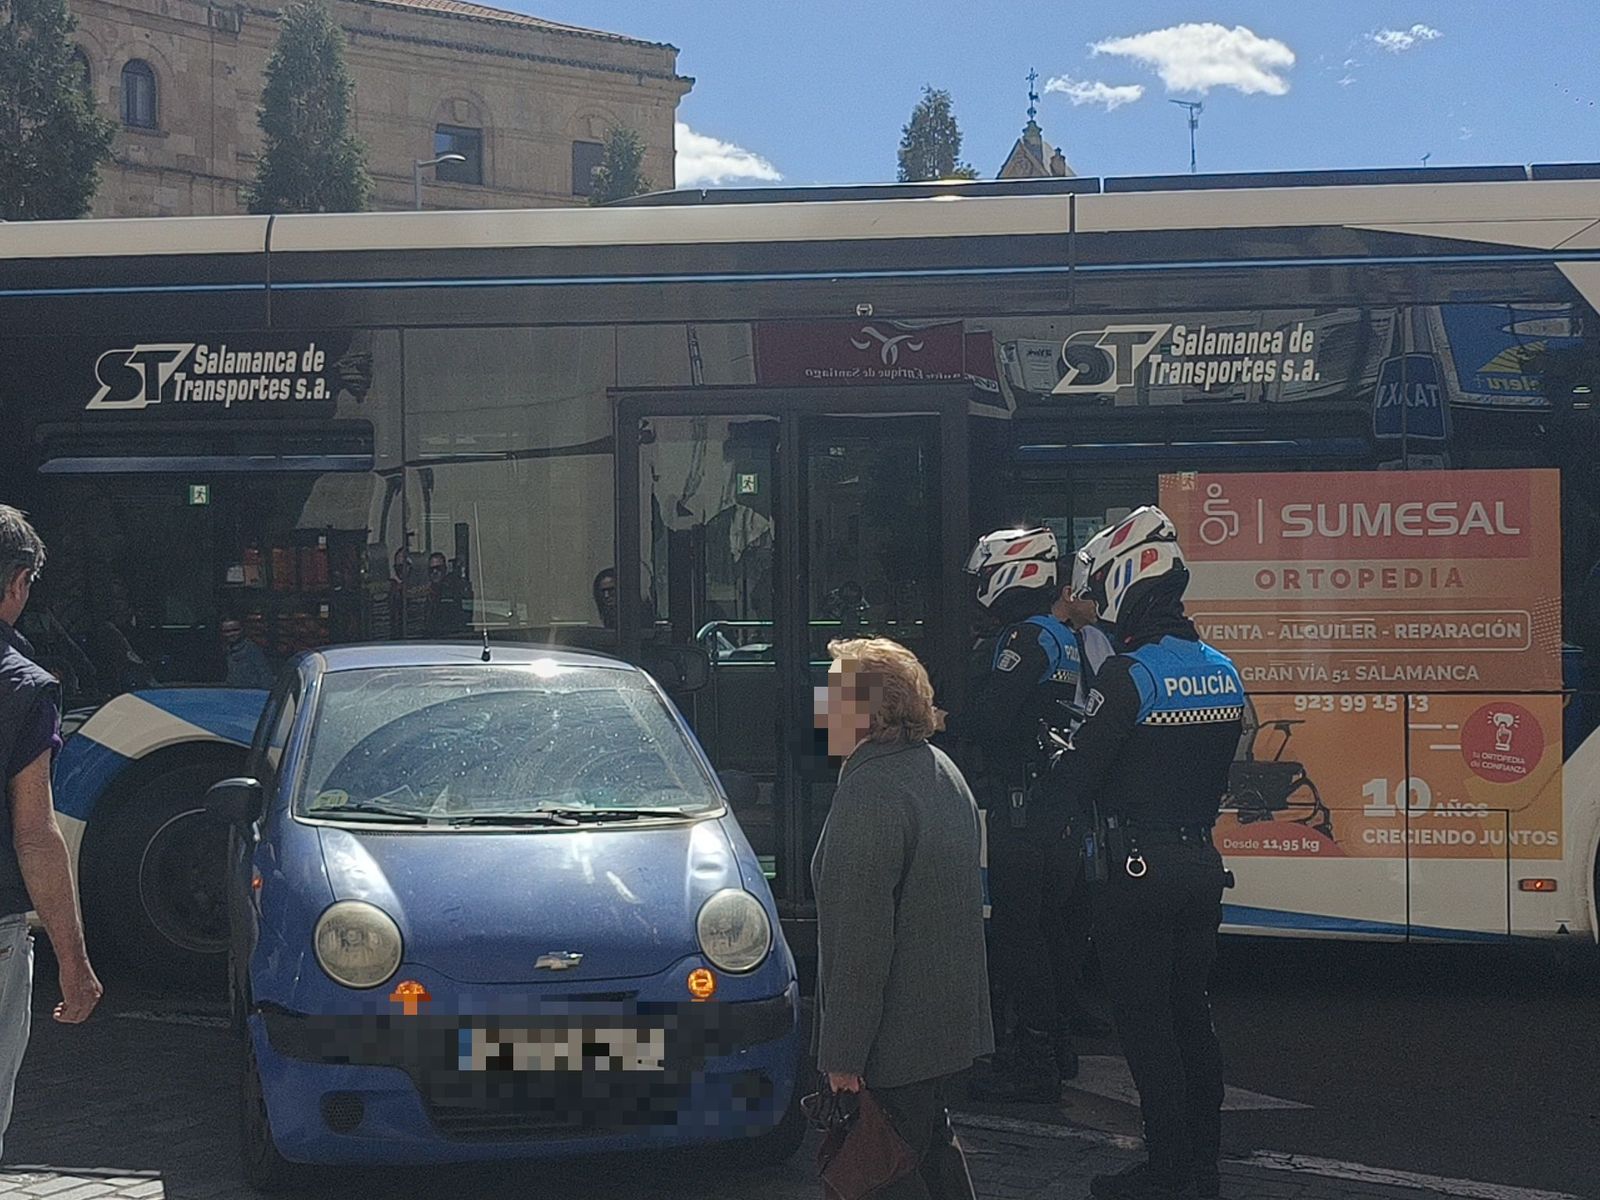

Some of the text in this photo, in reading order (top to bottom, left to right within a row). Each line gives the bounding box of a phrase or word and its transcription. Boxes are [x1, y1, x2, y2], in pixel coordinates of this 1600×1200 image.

[1170, 322, 1314, 356] Salamanca de
[193, 342, 325, 374] Salamanca de
[1149, 354, 1320, 391] Transportes s.a.
[173, 372, 331, 408] Transportes s.a.
[1280, 501, 1521, 538] SUMESAL
[1254, 566, 1465, 590] ORTOPEDIA
[1199, 623, 1263, 640] VENTA
[1279, 623, 1378, 642] ALQUILER
[1394, 619, 1521, 639] REPARACIÓN
[1164, 669, 1237, 697] POLICÍA
[1240, 665, 1294, 681] GRAN
[1298, 662, 1329, 681] VÍA
[1355, 664, 1480, 681] SALAMANCA
[1294, 694, 1335, 712] 923
[1340, 694, 1367, 712] 99
[1372, 695, 1398, 711] 15
[1481, 751, 1526, 764] ORTOPEDIA
[1481, 760, 1527, 774] CONFIANZA
[1361, 776, 1490, 818] 10 AÑOS
[1222, 837, 1320, 852] Desde 11,95 kg
[1361, 829, 1559, 846] CRECIENDO JUNTOS
